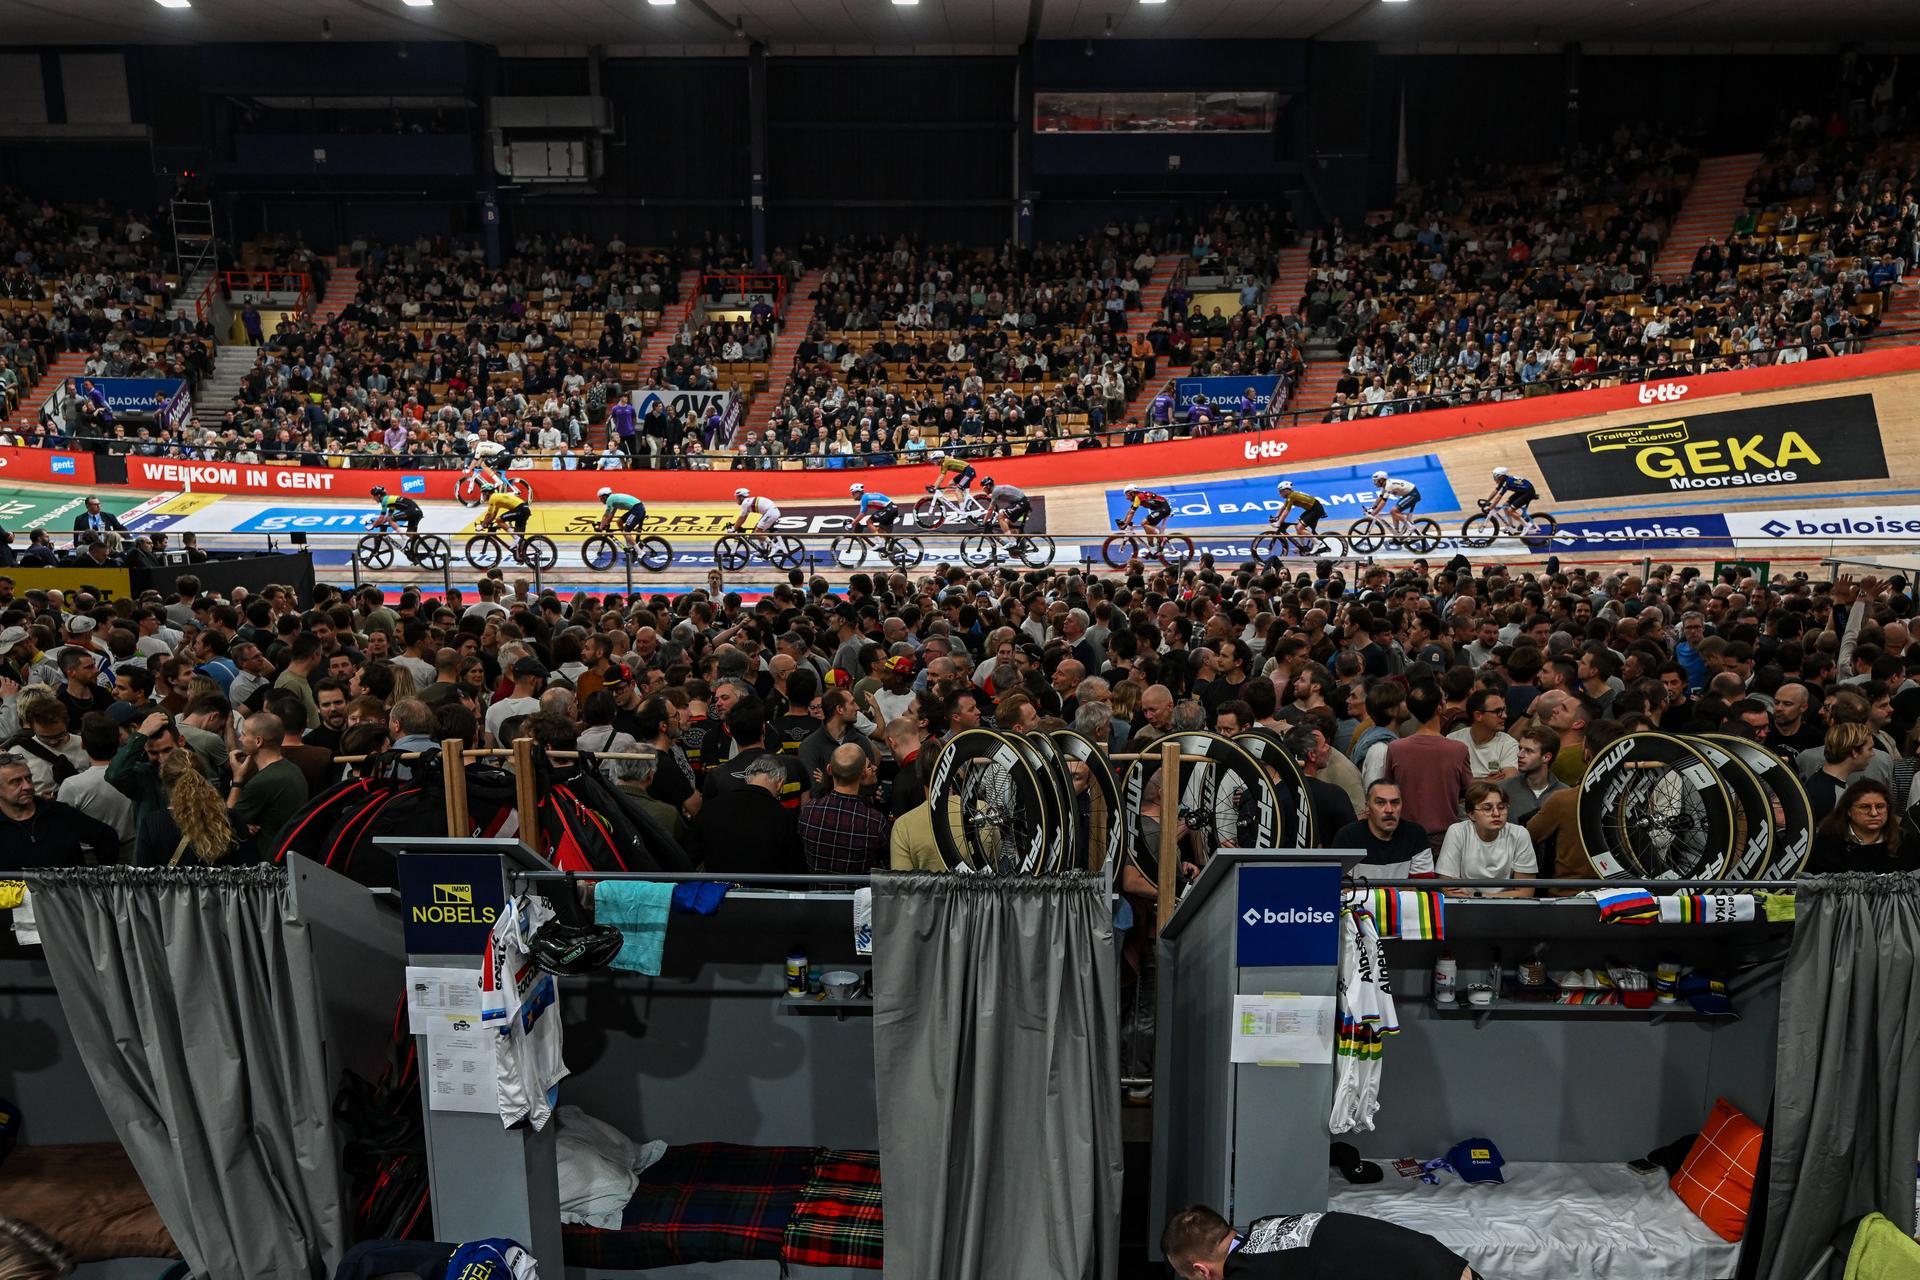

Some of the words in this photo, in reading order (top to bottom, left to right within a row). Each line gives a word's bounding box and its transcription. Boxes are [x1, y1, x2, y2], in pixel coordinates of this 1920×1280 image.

[1021, 207, 1030, 216] A
[108, 396, 172, 406] BADKAM
[1594, 430, 1644, 442] Traiteur
[1628, 430, 1683, 444] Catering
[1635, 431, 1822, 479] GEKA
[142, 463, 237, 486] WELKOM
[246, 468, 268, 487] IN
[277, 471, 334, 490] GENT
[1670, 469, 1798, 490] Moorslede
[1219, 491, 1402, 514] BADAMER
[255, 512, 382, 531] gent
[569, 515, 734, 526] SORT
[1796, 515, 1920, 535] baloise
[1584, 524, 1701, 545] baloise
[1584, 738, 1635, 793] FFWD
[930, 743, 957, 811] FFWD
[1126, 761, 1144, 858] FFWD
[1258, 778, 1273, 850] FFW
[412, 906, 496, 924] NOBELS
[1264, 906, 1335, 924] baloise
